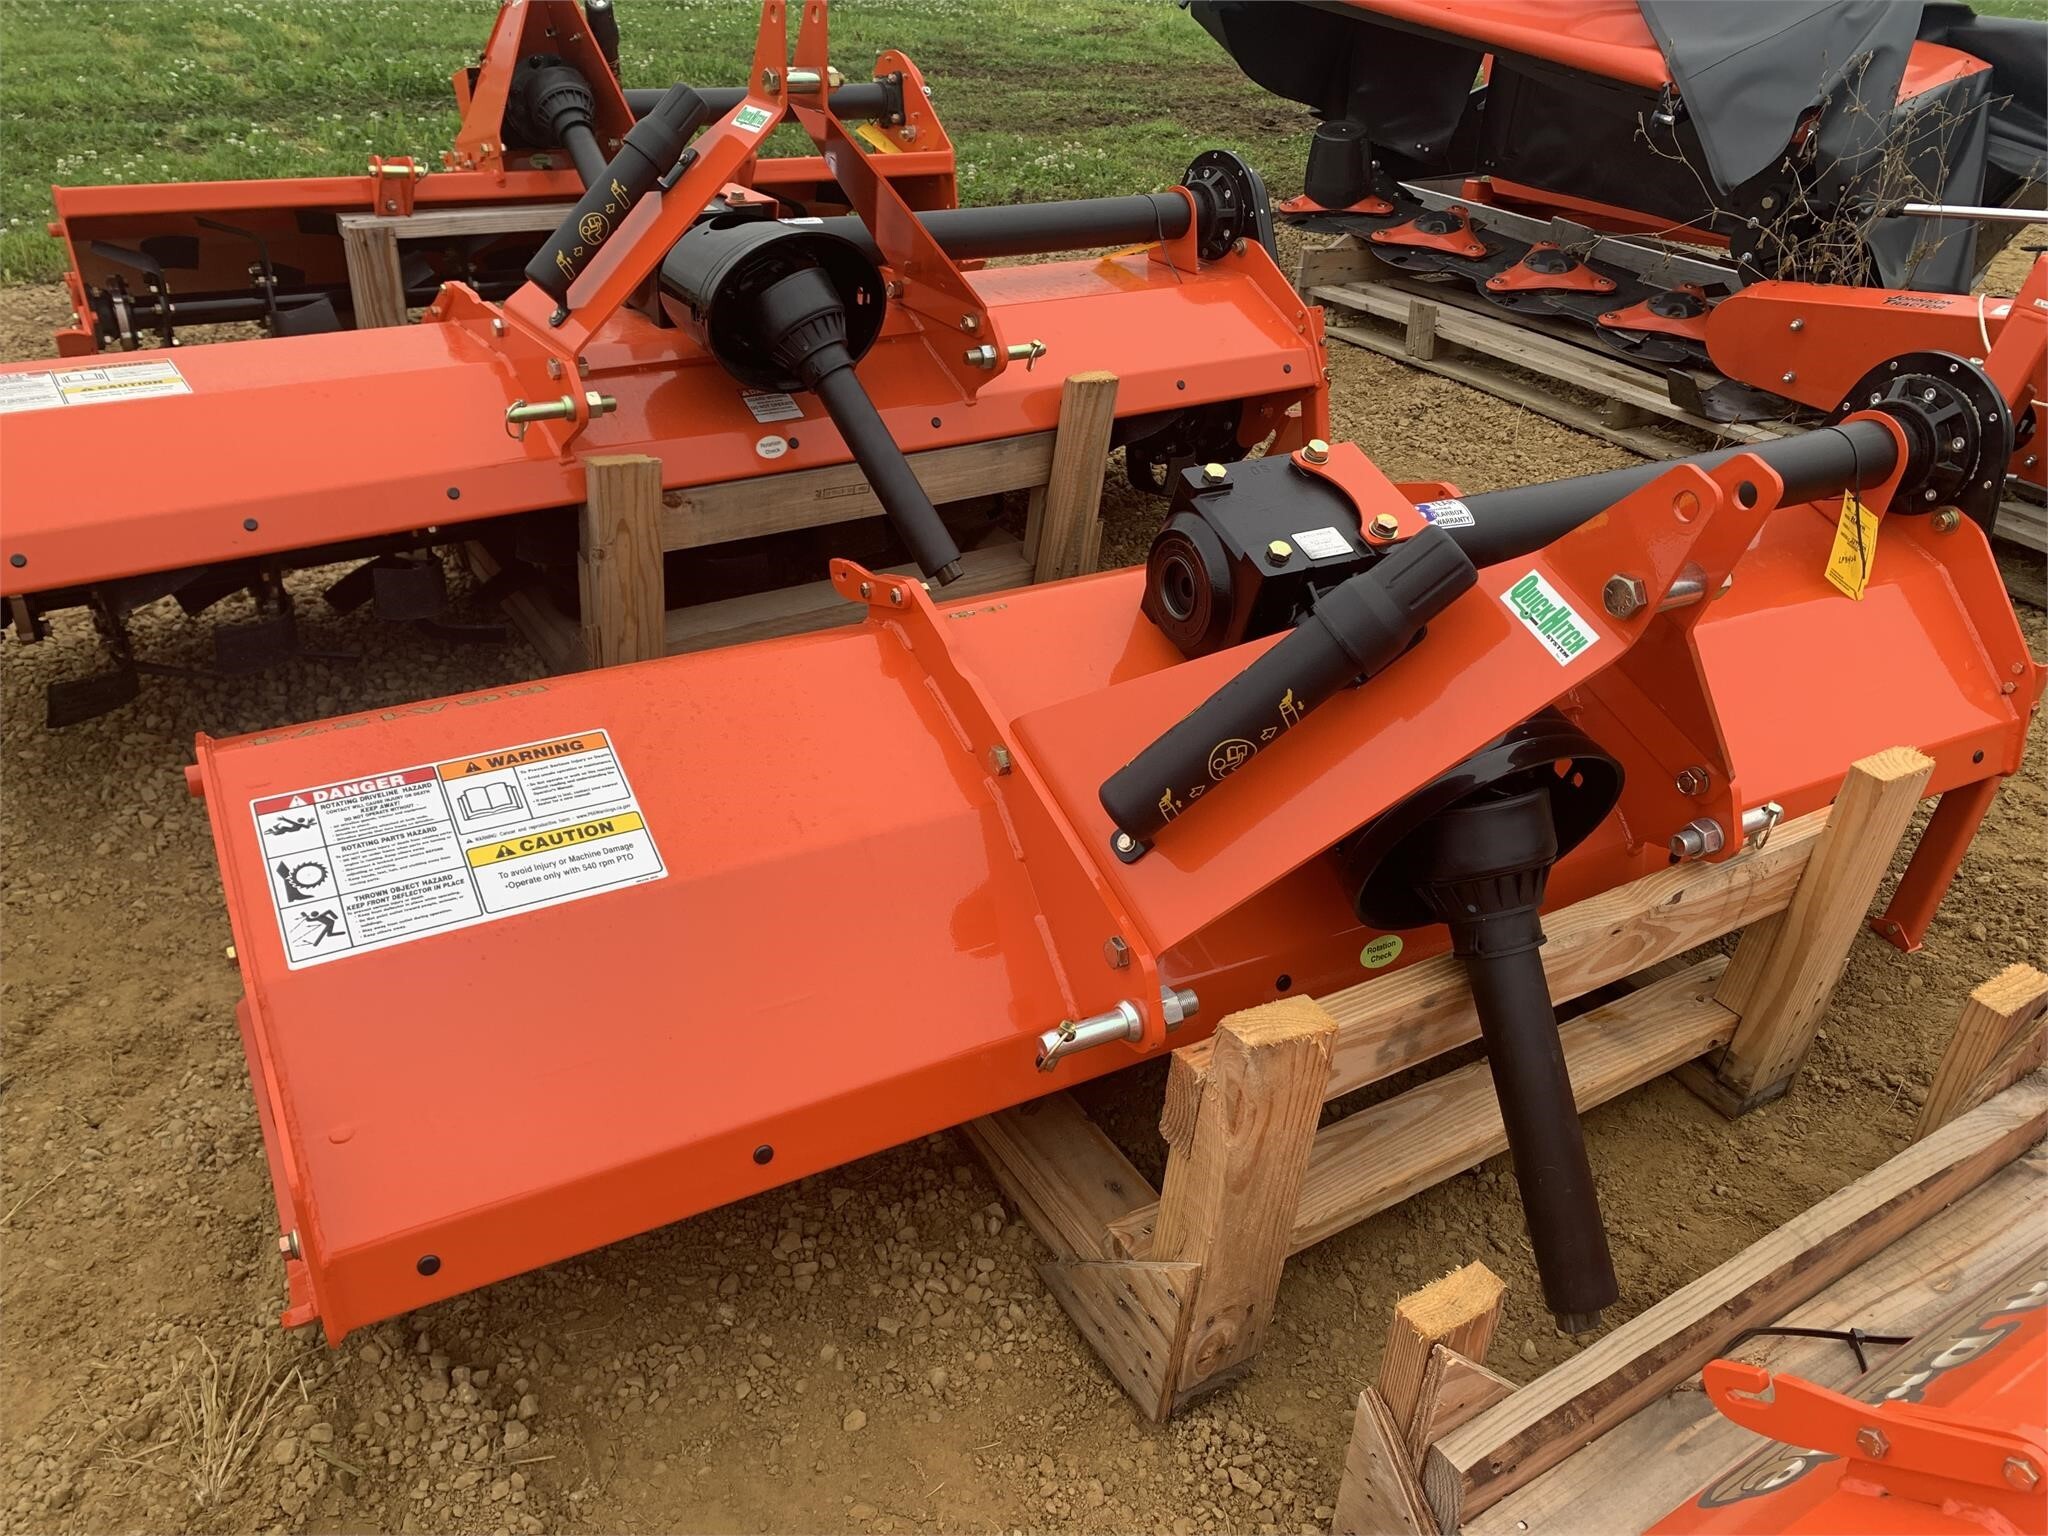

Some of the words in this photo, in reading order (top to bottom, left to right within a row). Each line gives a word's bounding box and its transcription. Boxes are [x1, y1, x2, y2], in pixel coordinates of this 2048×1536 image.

[86, 361, 153, 370] WARNING
[98, 380, 163, 391] CAUTION
[1436, 516, 1470, 525] WARRANTY
[1546, 634, 1570, 659] SYSTEM
[486, 739, 584, 768] WARNING
[313, 775, 405, 802] DANGER
[319, 797, 358, 810] ROTATING
[359, 788, 398, 801] DRIVELINE
[401, 781, 432, 792] HAZARD
[360, 805, 378, 813] KEEP
[379, 800, 400, 808] AWAY!
[340, 838, 379, 851] ROTATING
[380, 833, 405, 843] PARTS
[406, 826, 437, 837] HAZARD
[517, 820, 615, 852] CAUTION
[497, 870, 509, 880] To
[509, 865, 533, 877] avoid
[533, 859, 557, 872] Injury
[557, 856, 568, 866] or
[568, 848, 602, 863] Machine
[601, 841, 634, 855] Damage
[542, 869, 561, 881] only
[561, 865, 581, 876] with
[581, 861, 598, 872] 540
[597, 856, 616, 868] rpm
[615, 852, 635, 863] PTO
[345, 901, 365, 911] KEEP
[366, 896, 390, 906] FRONT
[391, 886, 432, 900] DEFLECTOR
[442, 878, 464, 888] PLACE
[354, 889, 388, 901] THROWN
[389, 881, 420, 893] OBJECT
[421, 874, 453, 886] HAZARD
[1368, 940, 1396, 954] Rotation
[1370, 951, 1392, 963] Check
